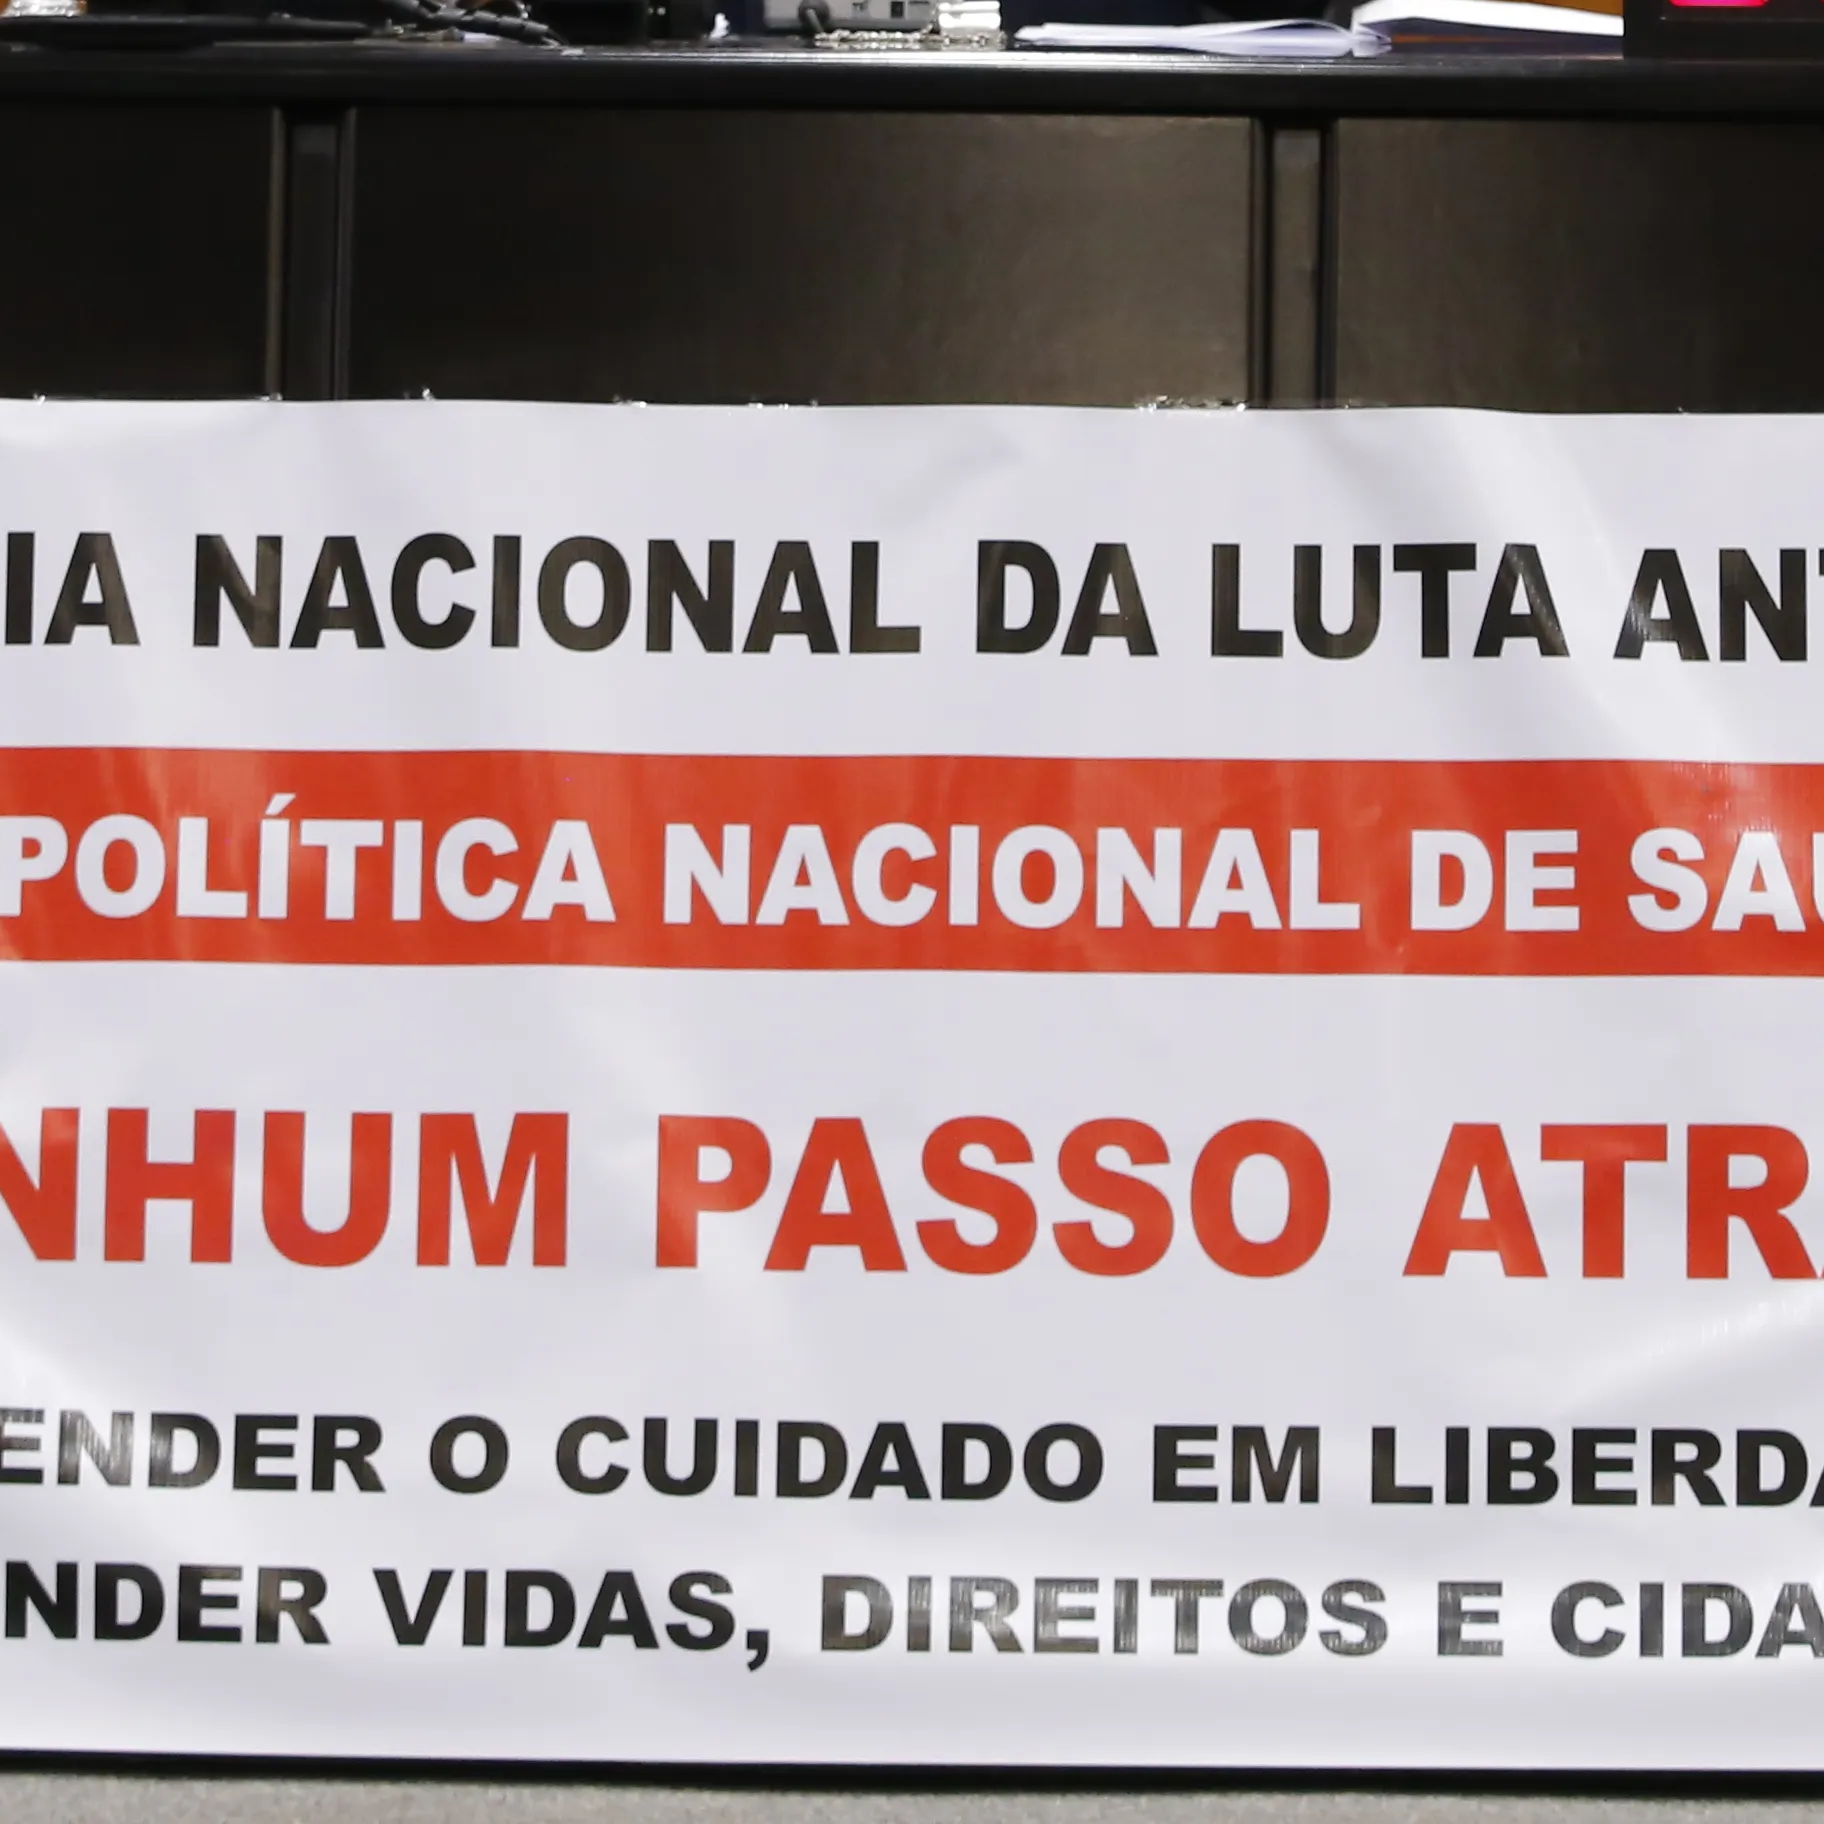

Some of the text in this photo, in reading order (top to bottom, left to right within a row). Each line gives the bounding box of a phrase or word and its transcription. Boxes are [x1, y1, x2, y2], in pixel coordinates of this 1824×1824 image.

[193, 532, 921, 654] NACIONAL
[975, 539, 1159, 657] DA
[1210, 542, 1570, 660] LUTA
[663, 822, 1361, 930] NACIONAL
[1410, 829, 1580, 932] DE
[656, 1115, 1330, 1278] PASSO
[429, 1415, 509, 1495] O
[555, 1415, 1104, 1503] CUIDADO
[1152, 1424, 1320, 1504] EM
[372, 1568, 770, 1673] VIDAS,
[821, 1575, 1387, 1657] DIREITOS
[1437, 1581, 1502, 1657] E
